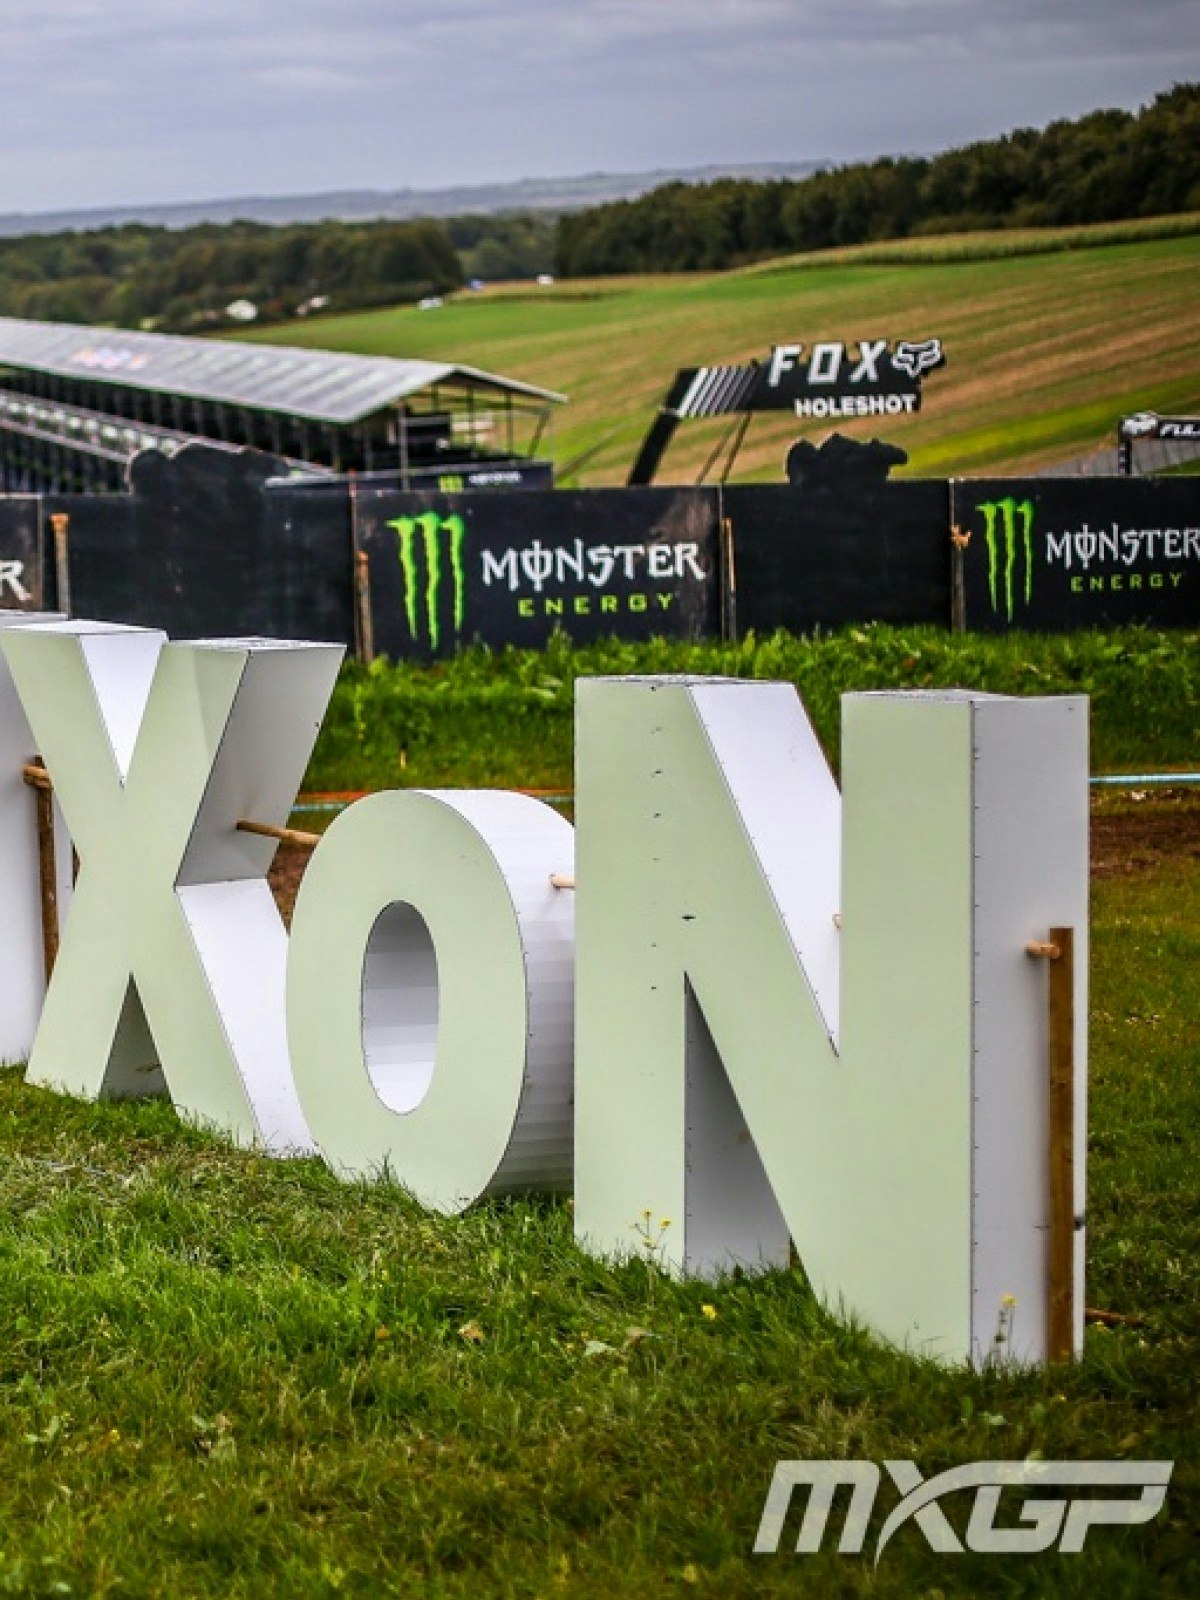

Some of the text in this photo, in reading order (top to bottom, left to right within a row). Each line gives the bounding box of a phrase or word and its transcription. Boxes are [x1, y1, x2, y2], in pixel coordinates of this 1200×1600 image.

[767, 340, 887, 387] FOX
[794, 394, 917, 418] HOLESHOT
[1045, 522, 1200, 570] MONSTER
[480, 538, 706, 591] MONSTER
[1070, 572, 1182, 592] ENERGY
[517, 592, 675, 617] ENERGY
